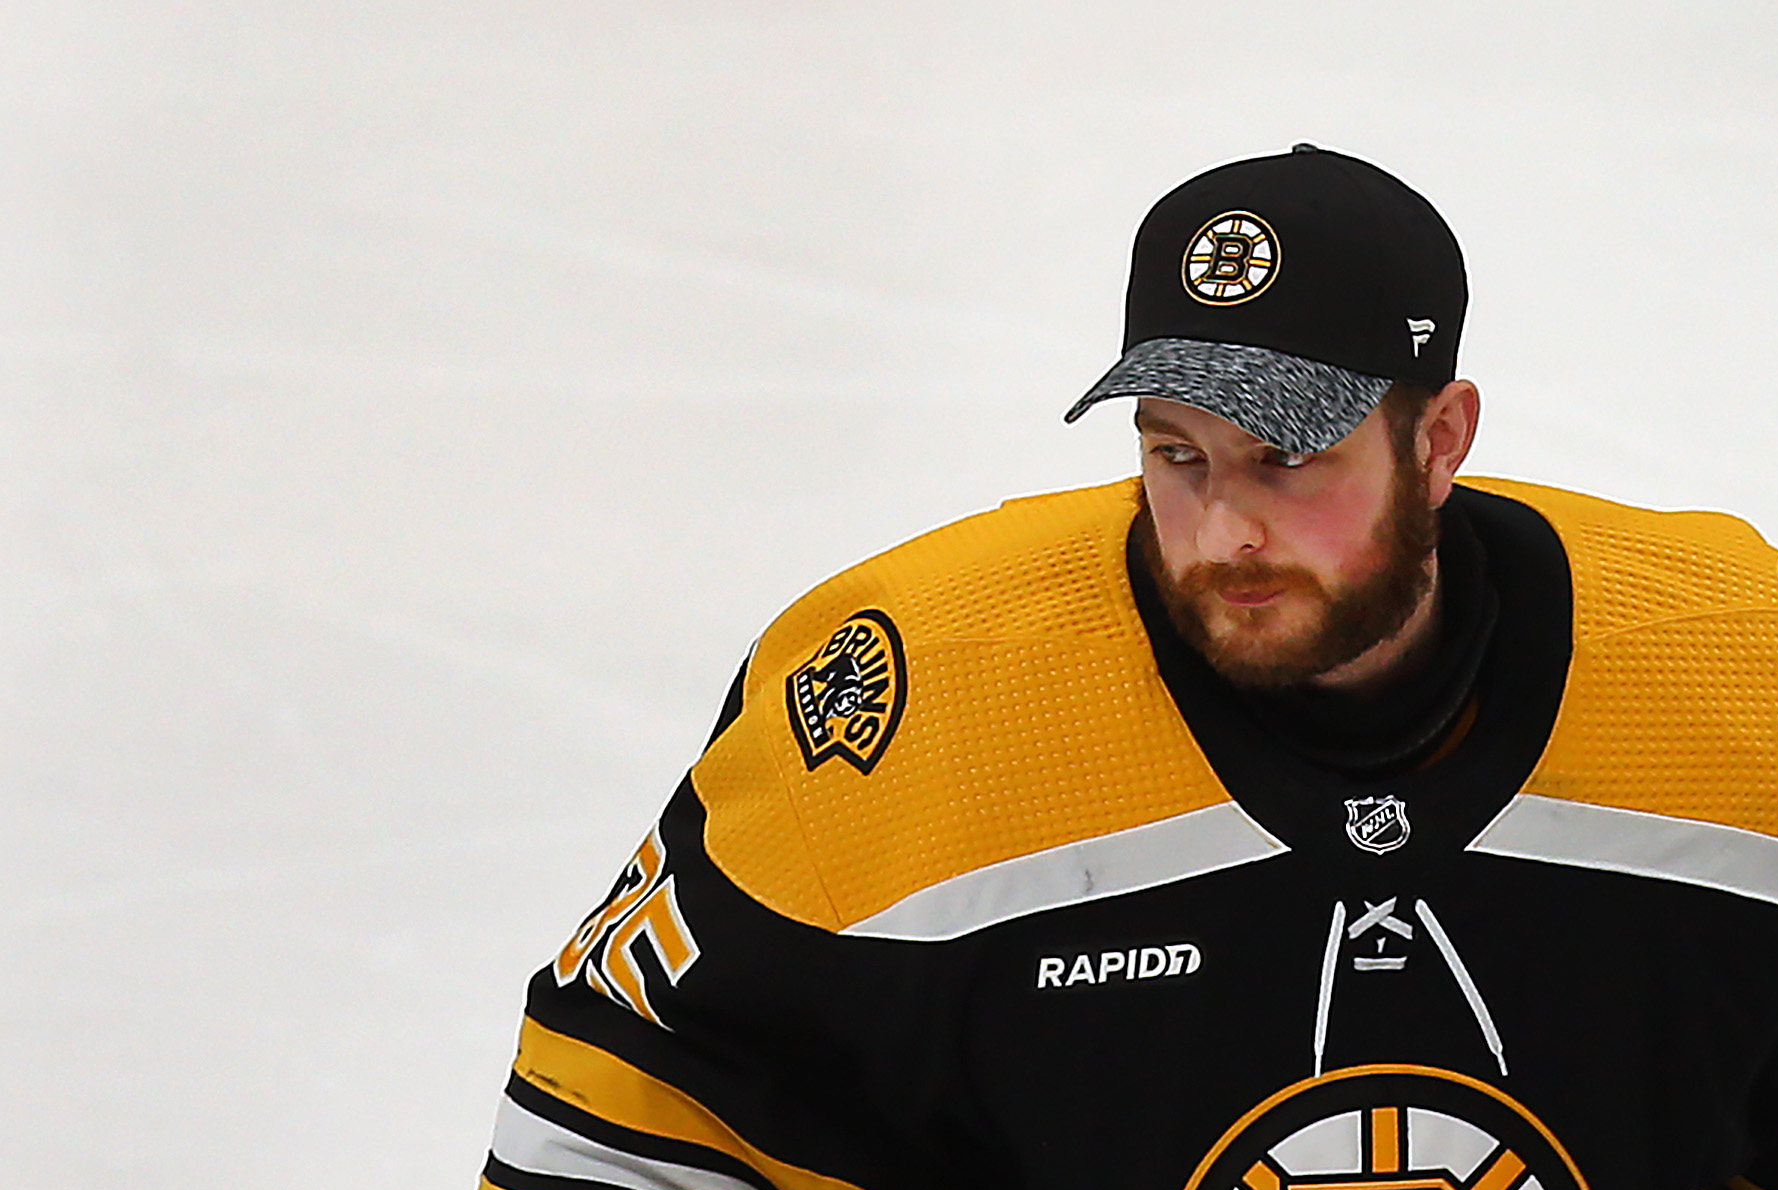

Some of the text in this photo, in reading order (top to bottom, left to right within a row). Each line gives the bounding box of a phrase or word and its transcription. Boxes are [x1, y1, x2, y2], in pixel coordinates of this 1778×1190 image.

[1209, 234, 1250, 283] B
[822, 624, 890, 751] BRUINS
[1362, 808, 1395, 839] NHL
